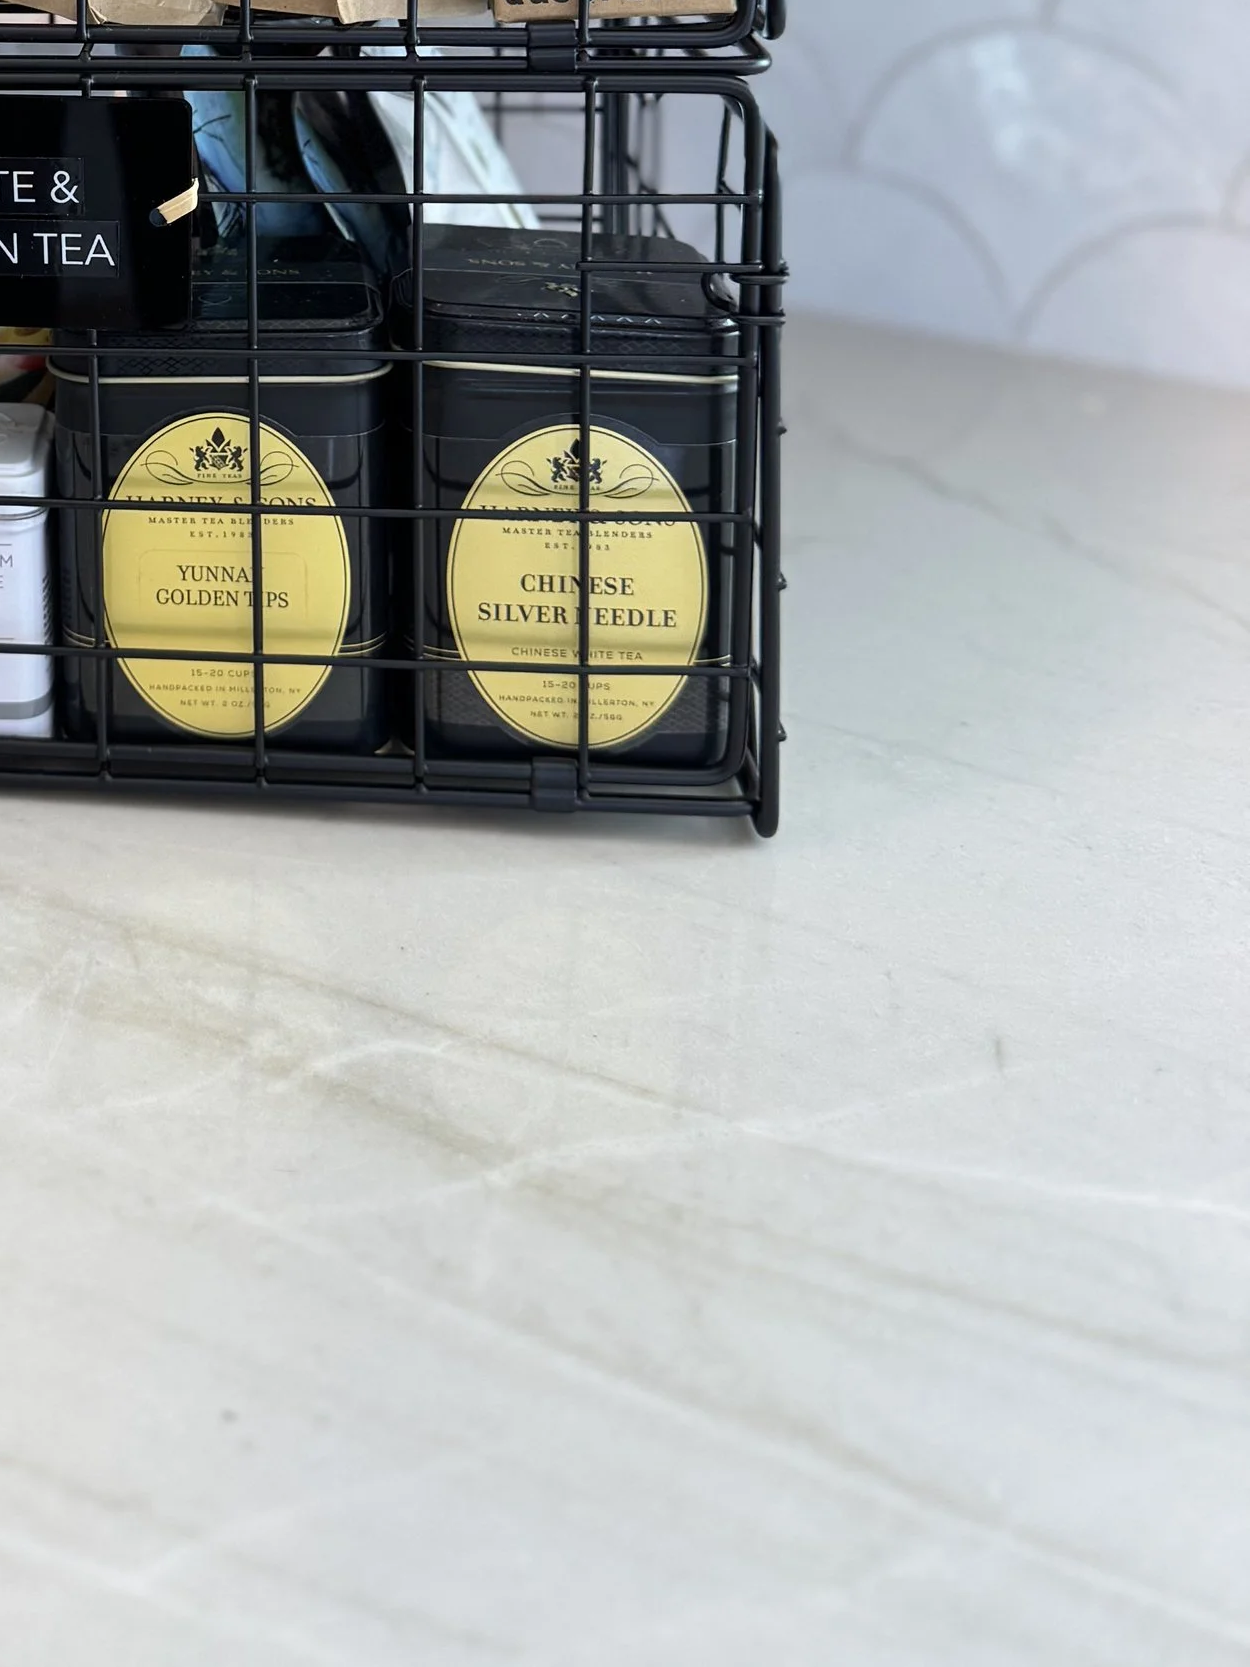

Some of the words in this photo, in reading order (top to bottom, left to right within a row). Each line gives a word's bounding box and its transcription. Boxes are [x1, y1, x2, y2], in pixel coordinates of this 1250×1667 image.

[50, 170, 80, 204] &
[33, 233, 116, 266] TEA
[149, 517, 197, 525] MASTER
[231, 518, 295, 526] BLEDERS
[502, 527, 552, 536] MASTER
[177, 565, 265, 583] YUNNA
[520, 573, 635, 596] CHINESE
[156, 588, 240, 606] GOLDEN
[243, 590, 290, 609] TPS
[477, 602, 569, 625] SILVER
[511, 647, 568, 658] CHINESE
[619, 651, 643, 661] TEA
[588, 682, 611, 691] UPS
